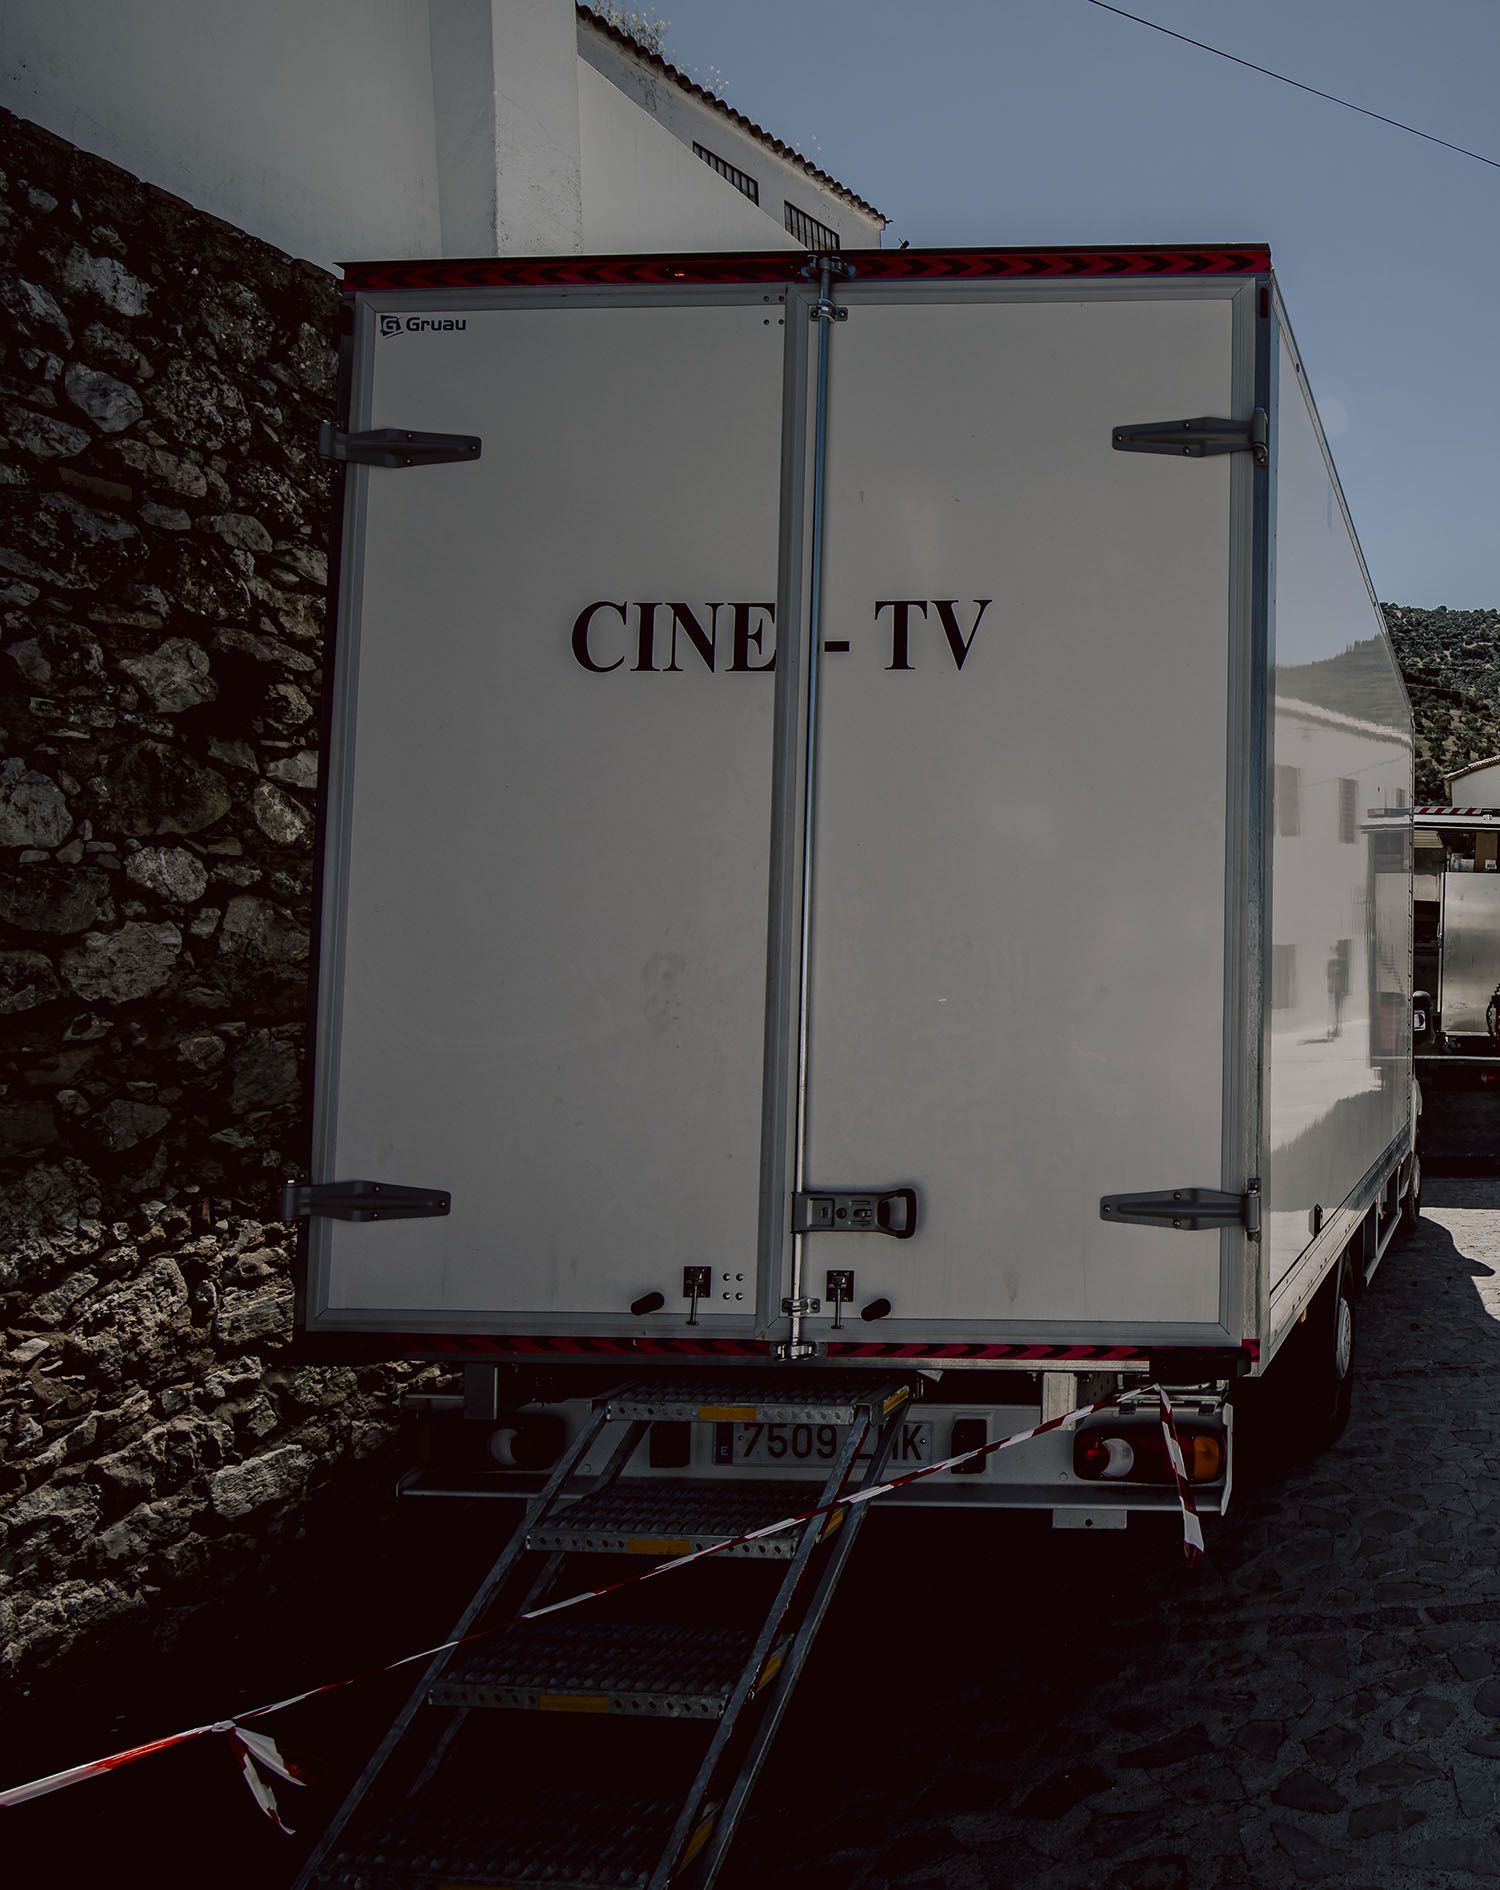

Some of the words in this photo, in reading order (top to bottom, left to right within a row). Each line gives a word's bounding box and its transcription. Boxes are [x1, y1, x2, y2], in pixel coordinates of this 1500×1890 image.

[406, 317, 467, 332] Gruau
[571, 600, 777, 674] CINE
[873, 598, 993, 672] TV
[742, 1422, 838, 1460] 7509
